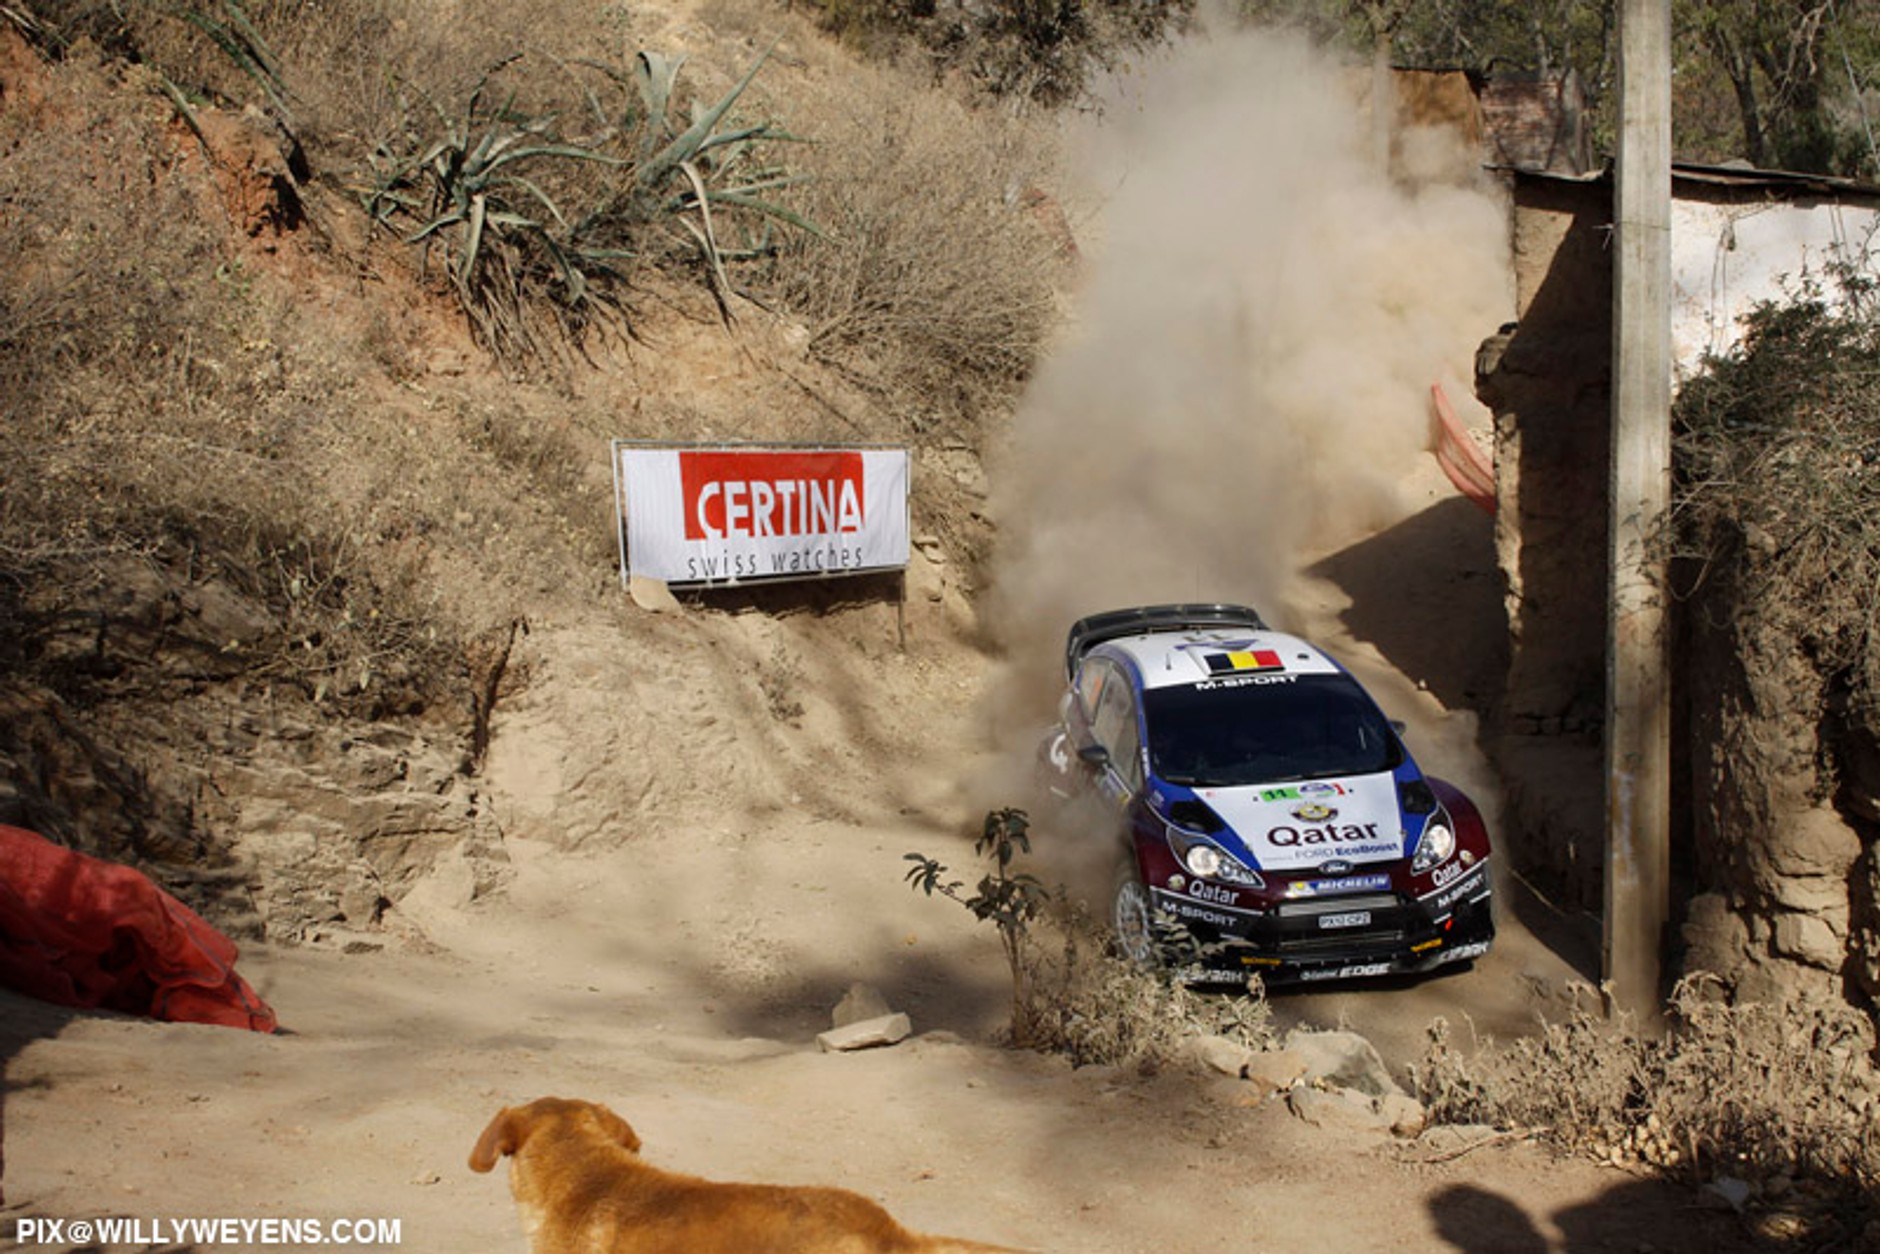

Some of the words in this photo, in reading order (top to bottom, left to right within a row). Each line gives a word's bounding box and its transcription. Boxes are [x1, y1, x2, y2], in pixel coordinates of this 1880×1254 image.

[697, 478, 864, 540] CERTINA
[688, 548, 757, 579] swiss
[771, 543, 863, 573] watches
[1195, 674, 1297, 691] M-SPORT
[1267, 822, 1378, 847] Qatar
[1295, 846, 1334, 859] FORD
[1335, 842, 1399, 857] EcoBoost
[1316, 875, 1389, 889] MICHELIN
[1431, 859, 1464, 887] Qatar
[1188, 879, 1239, 905] Qatar
[1438, 873, 1484, 908] M-SPORT
[1162, 900, 1238, 927] M-SPORT
[1339, 962, 1391, 978] EDGE
